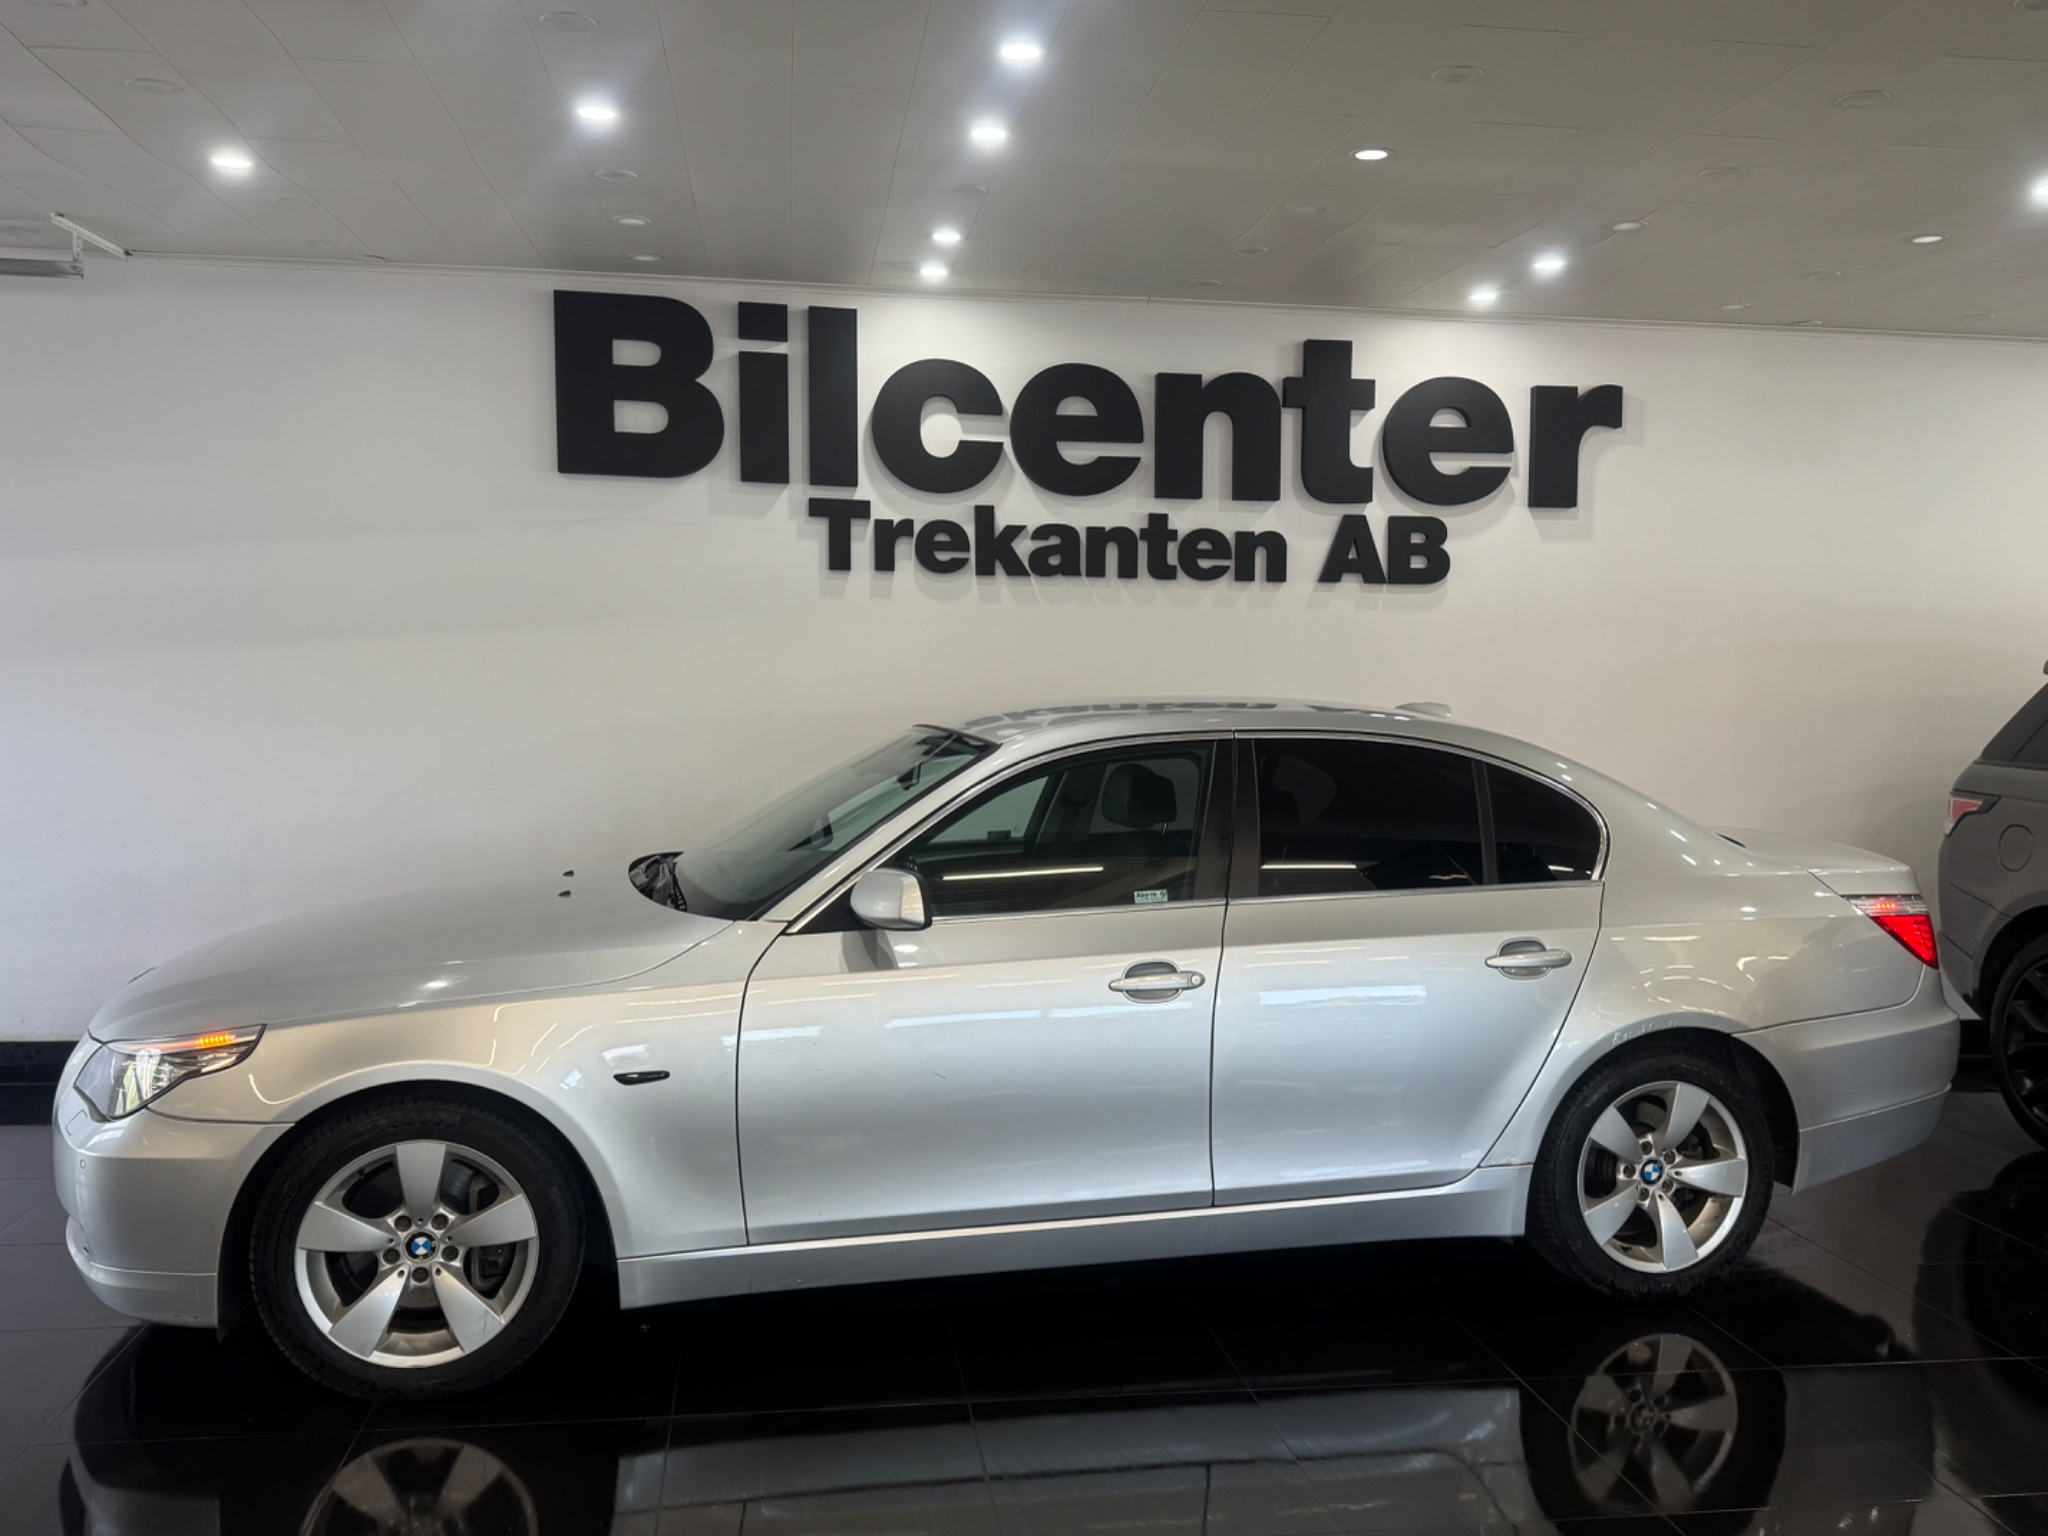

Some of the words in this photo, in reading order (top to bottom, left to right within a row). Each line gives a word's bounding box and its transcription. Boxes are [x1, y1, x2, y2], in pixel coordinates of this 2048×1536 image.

[553, 289, 1623, 508] Bilcenter
[808, 498, 1287, 583] Trekanten
[1318, 514, 1451, 585] AB
